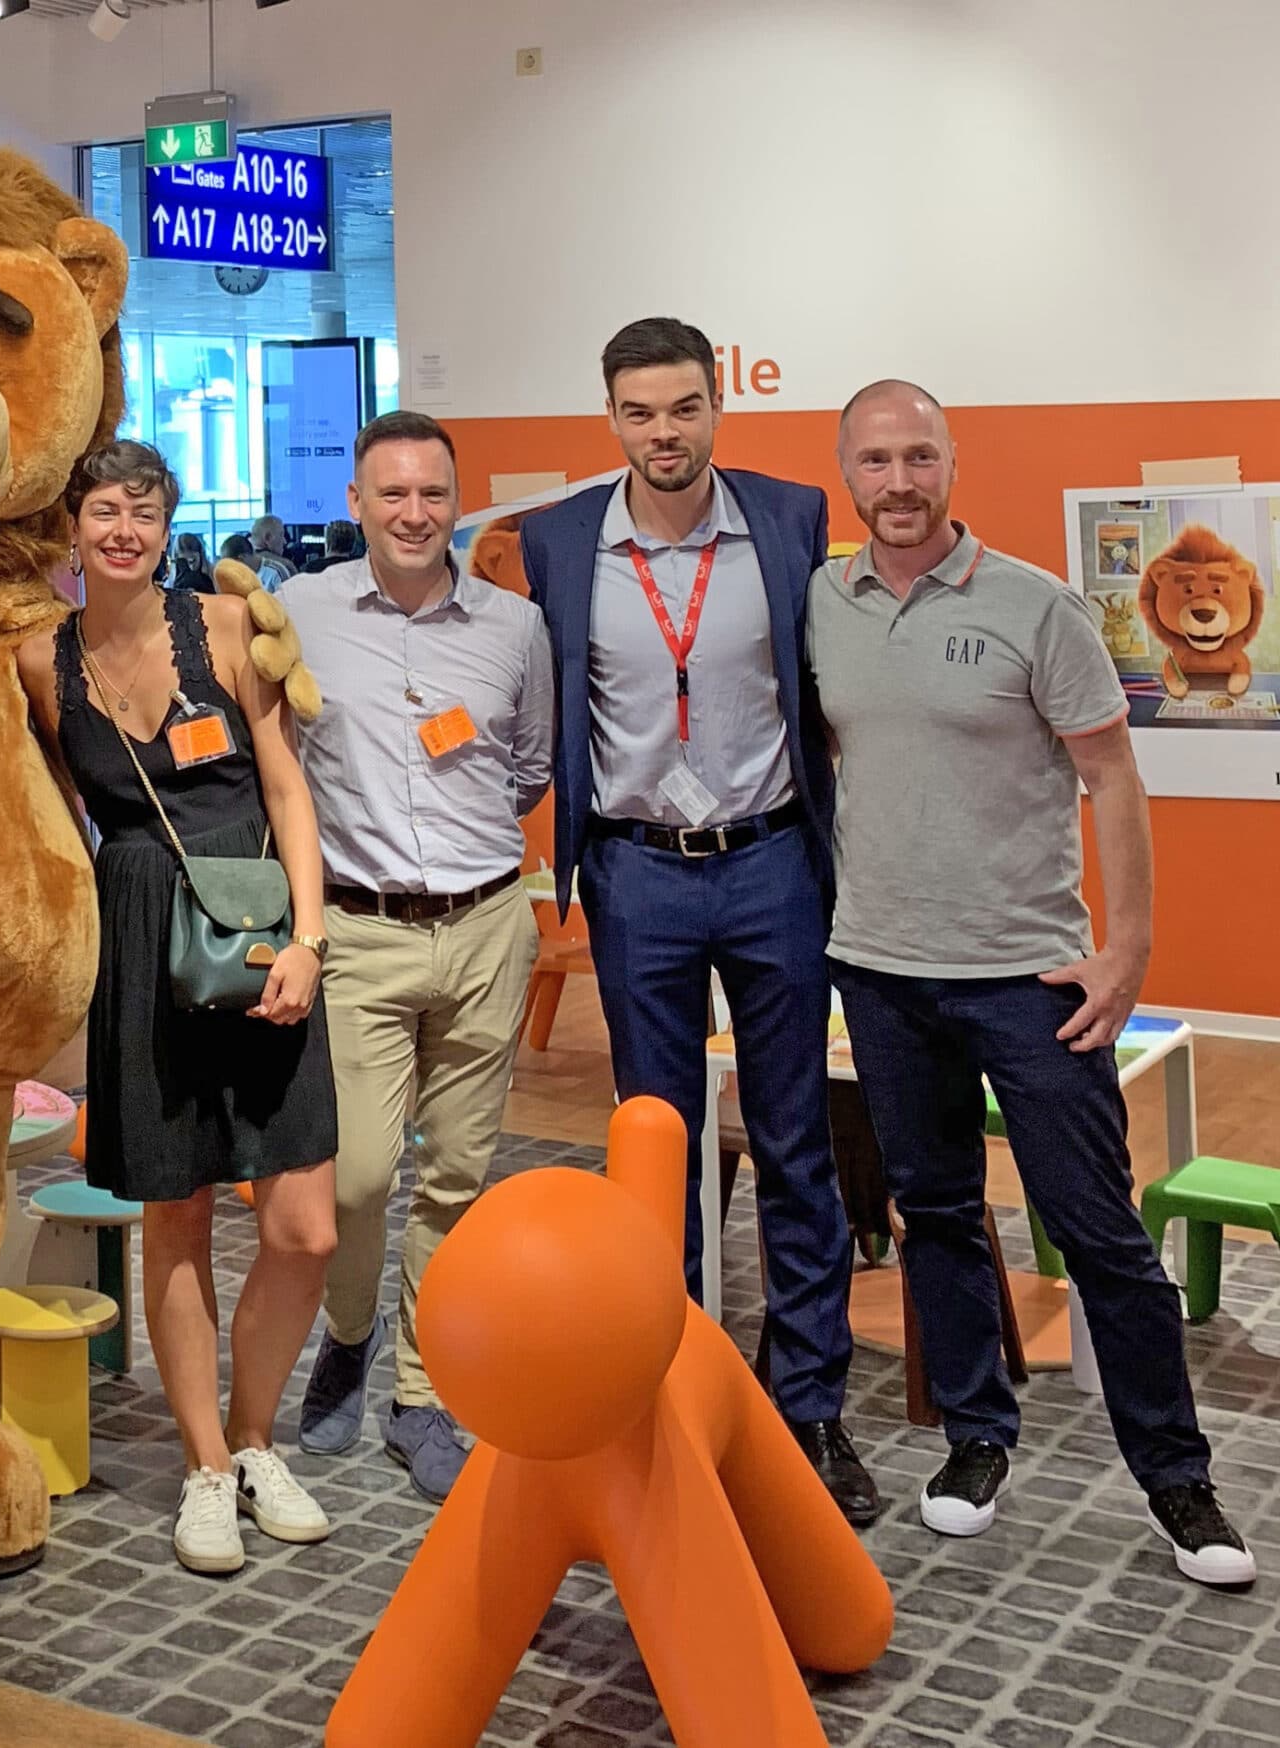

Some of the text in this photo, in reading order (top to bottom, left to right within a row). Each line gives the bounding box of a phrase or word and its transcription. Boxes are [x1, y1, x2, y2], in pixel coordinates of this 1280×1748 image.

[196, 152, 308, 200] Gates A10-16
[173, 205, 308, 258] A17 A18-20
[715, 345, 782, 396] ile
[946, 636, 985, 665] GAP
